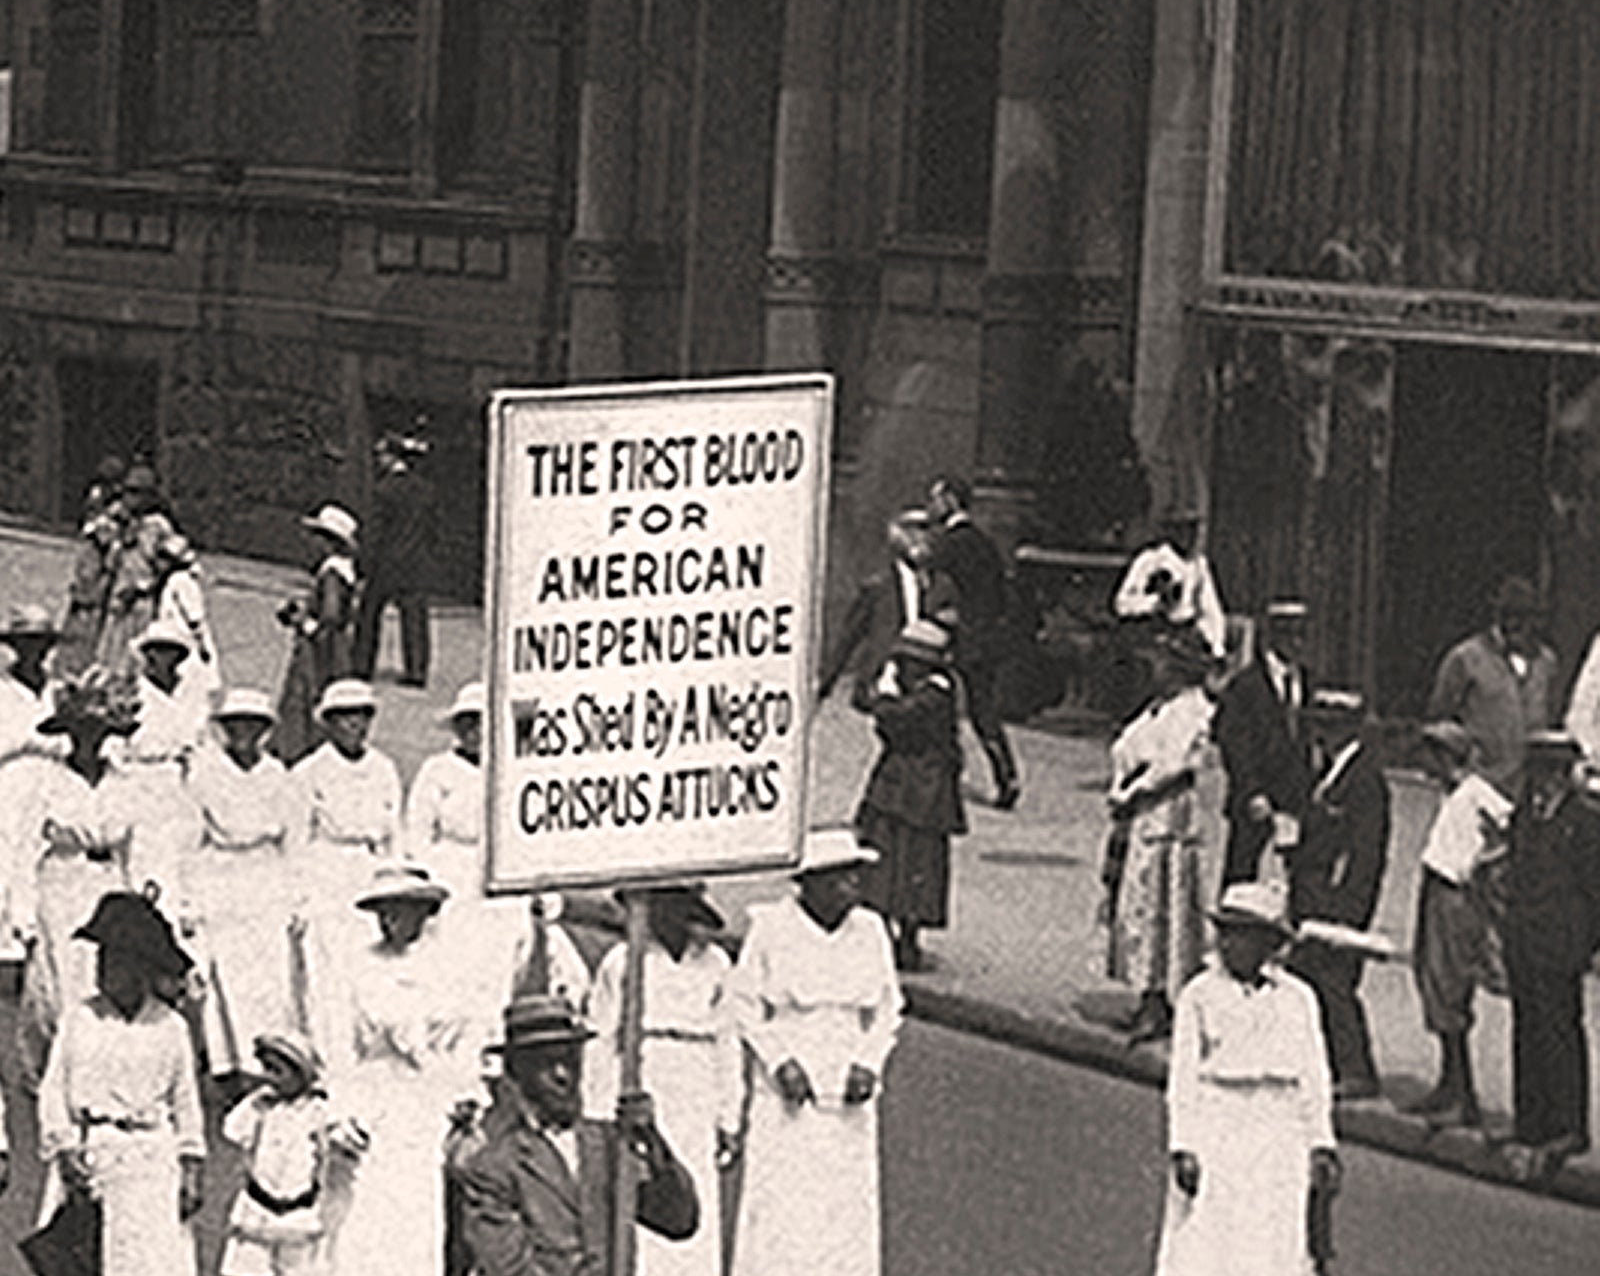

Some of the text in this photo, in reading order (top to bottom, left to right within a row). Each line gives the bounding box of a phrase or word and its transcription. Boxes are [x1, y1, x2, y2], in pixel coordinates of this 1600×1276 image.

[526, 428, 804, 498] THE FIRST BLOOD
[608, 501, 709, 537] FOR
[538, 543, 766, 604] AMERICAN
[511, 604, 795, 674] INDEPENDENCE
[510, 680, 794, 760] Was Shed By A Negro
[518, 759, 781, 835] CRISPUS ATTUCKS
